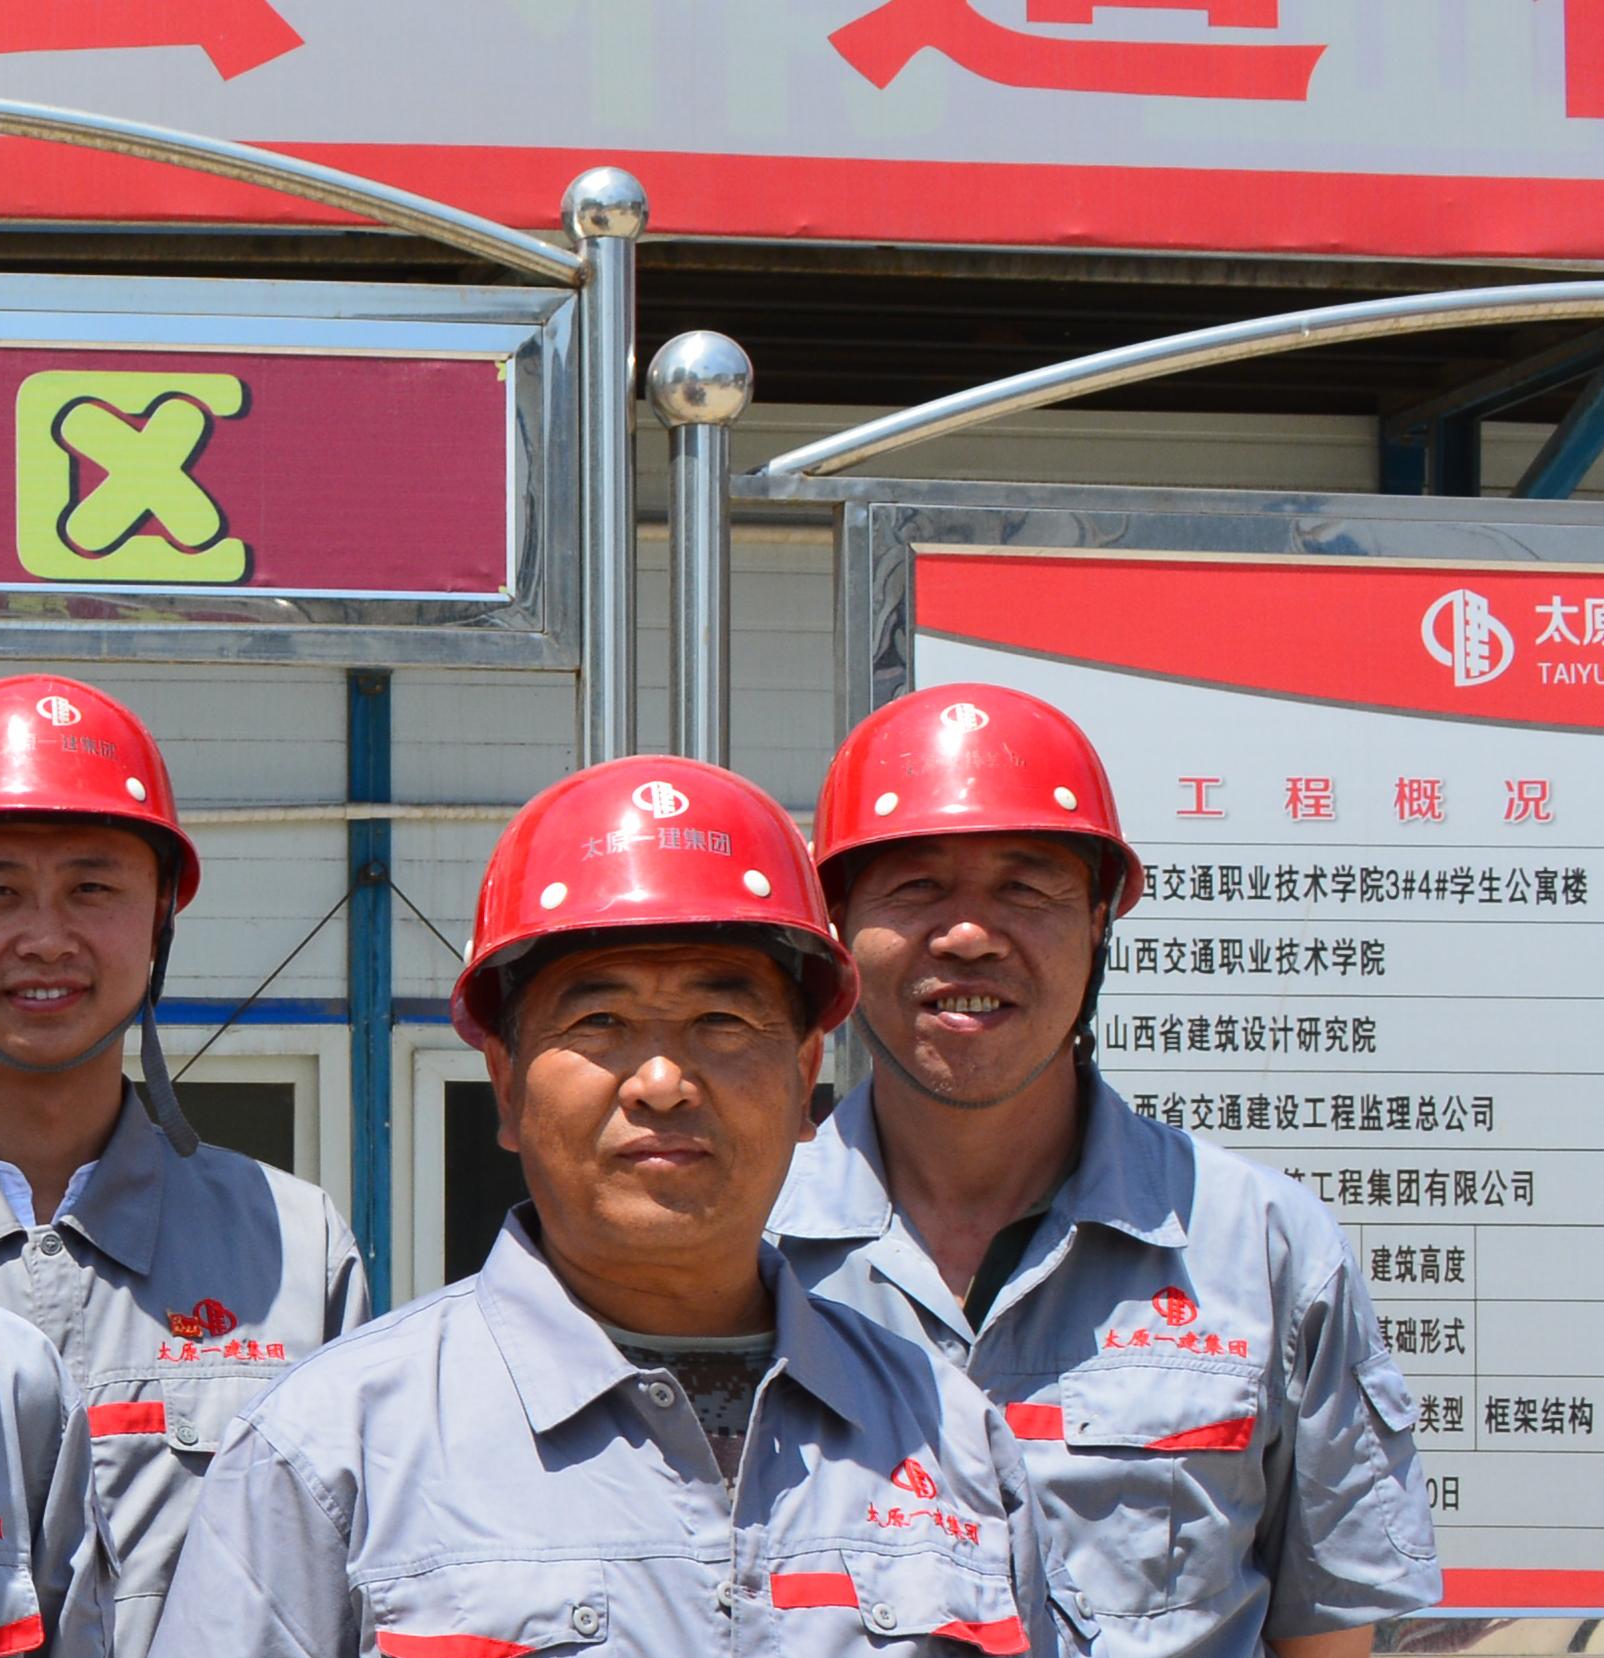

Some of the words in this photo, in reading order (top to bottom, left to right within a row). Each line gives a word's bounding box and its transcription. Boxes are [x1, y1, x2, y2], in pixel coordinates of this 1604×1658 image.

[1176, 776, 1555, 822] 工程概况
[581, 827, 732, 862] 太原一建集团
[1107, 937, 1385, 977] 山西交通职业技术学院
[1105, 1014, 1377, 1054] 山西省建筑设计研究院
[1282, 1167, 1535, 1208] 工程集团有限公司
[1370, 1243, 1466, 1284] 建筑高度
[158, 1339, 285, 1362] 太原一建集团
[1103, 1329, 1248, 1358] 太原一建集团
[1407, 1394, 1465, 1434] 类型
[1484, 1396, 1594, 1435] 框架结构
